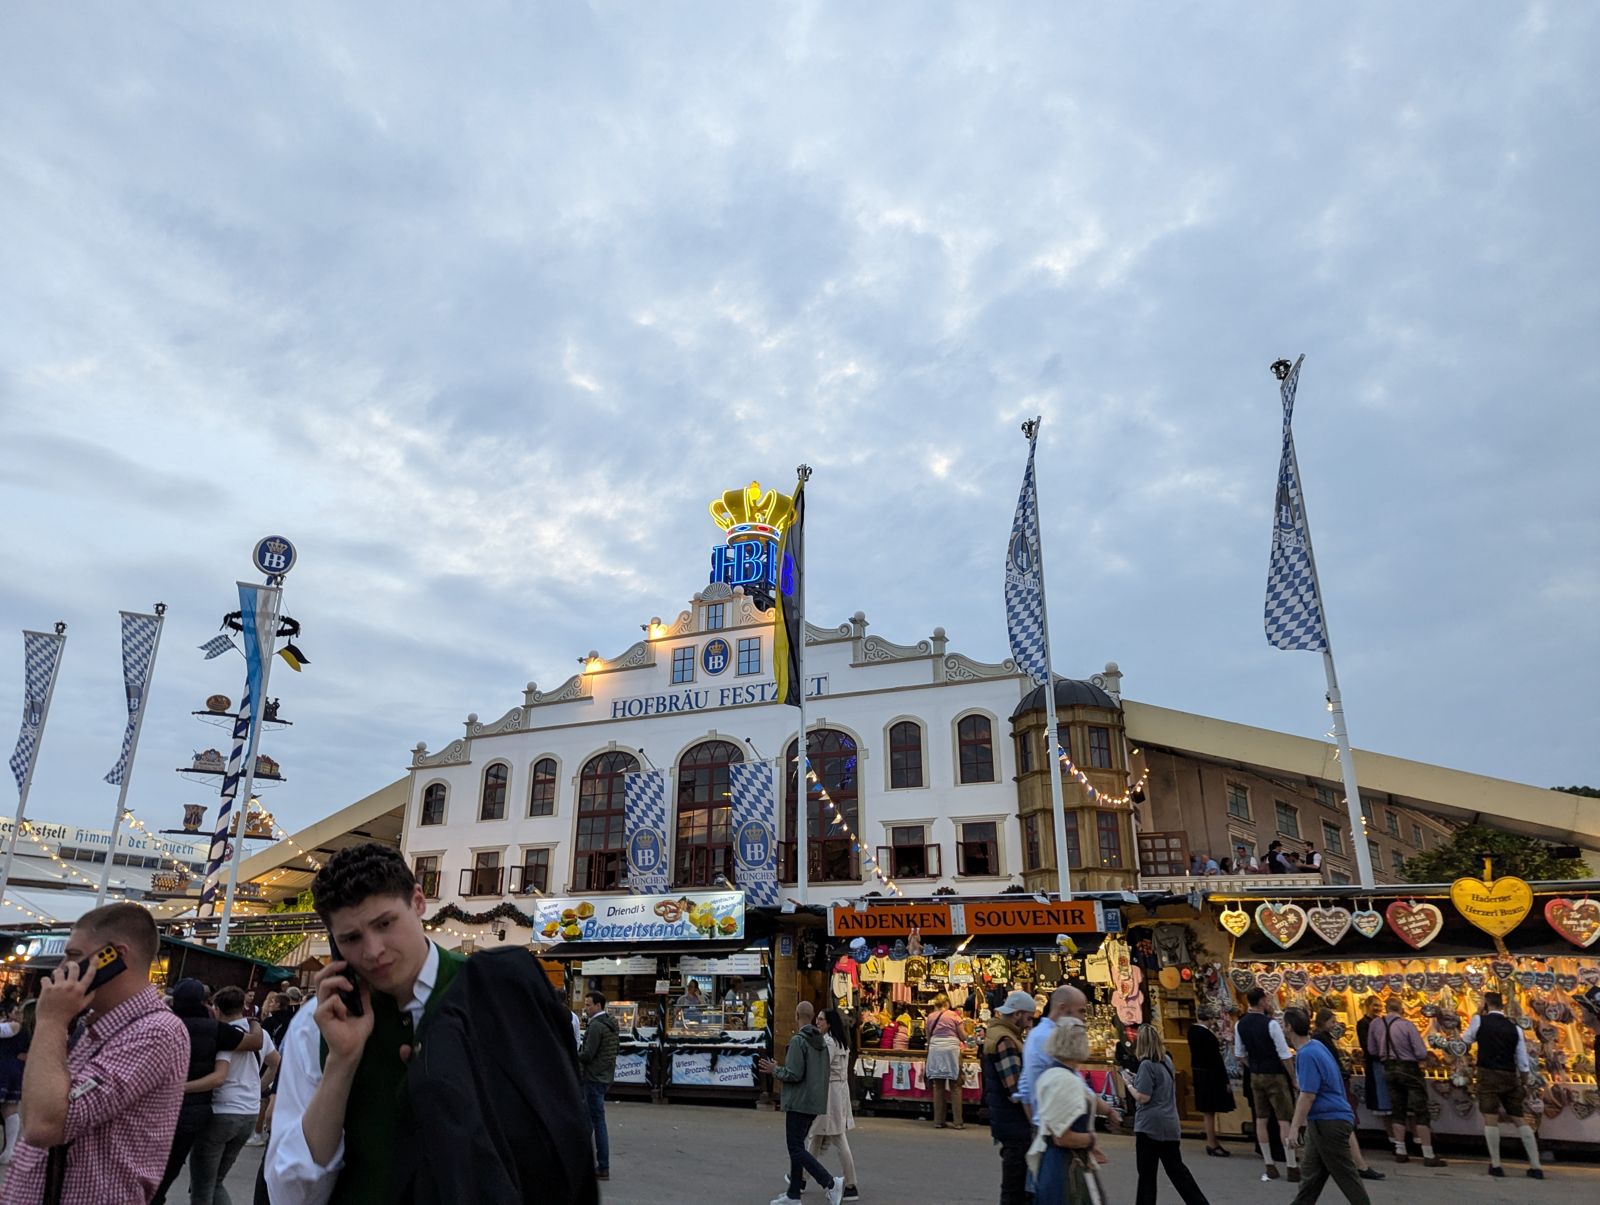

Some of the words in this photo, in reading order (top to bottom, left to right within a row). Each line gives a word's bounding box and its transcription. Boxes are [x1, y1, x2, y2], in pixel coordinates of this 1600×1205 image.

[263, 552, 286, 569] HB
[712, 540, 764, 586] HB
[708, 655, 724, 670] HB
[611, 689, 710, 718] HOFBRÄU
[719, 676, 828, 706] FESTZLT
[0, 821, 15, 833] er
[75, 829, 123, 847] Himml
[128, 836, 147, 849] der
[637, 849, 655, 867] HB
[745, 843, 765, 861] HB
[629, 874, 668, 886] MÜNCHEN
[736, 871, 777, 881] MÜNCHEN
[838, 913, 947, 929] ANDENKEN
[974, 909, 1086, 927] SOUVENIR
[584, 919, 687, 938] Brotzeitstand
